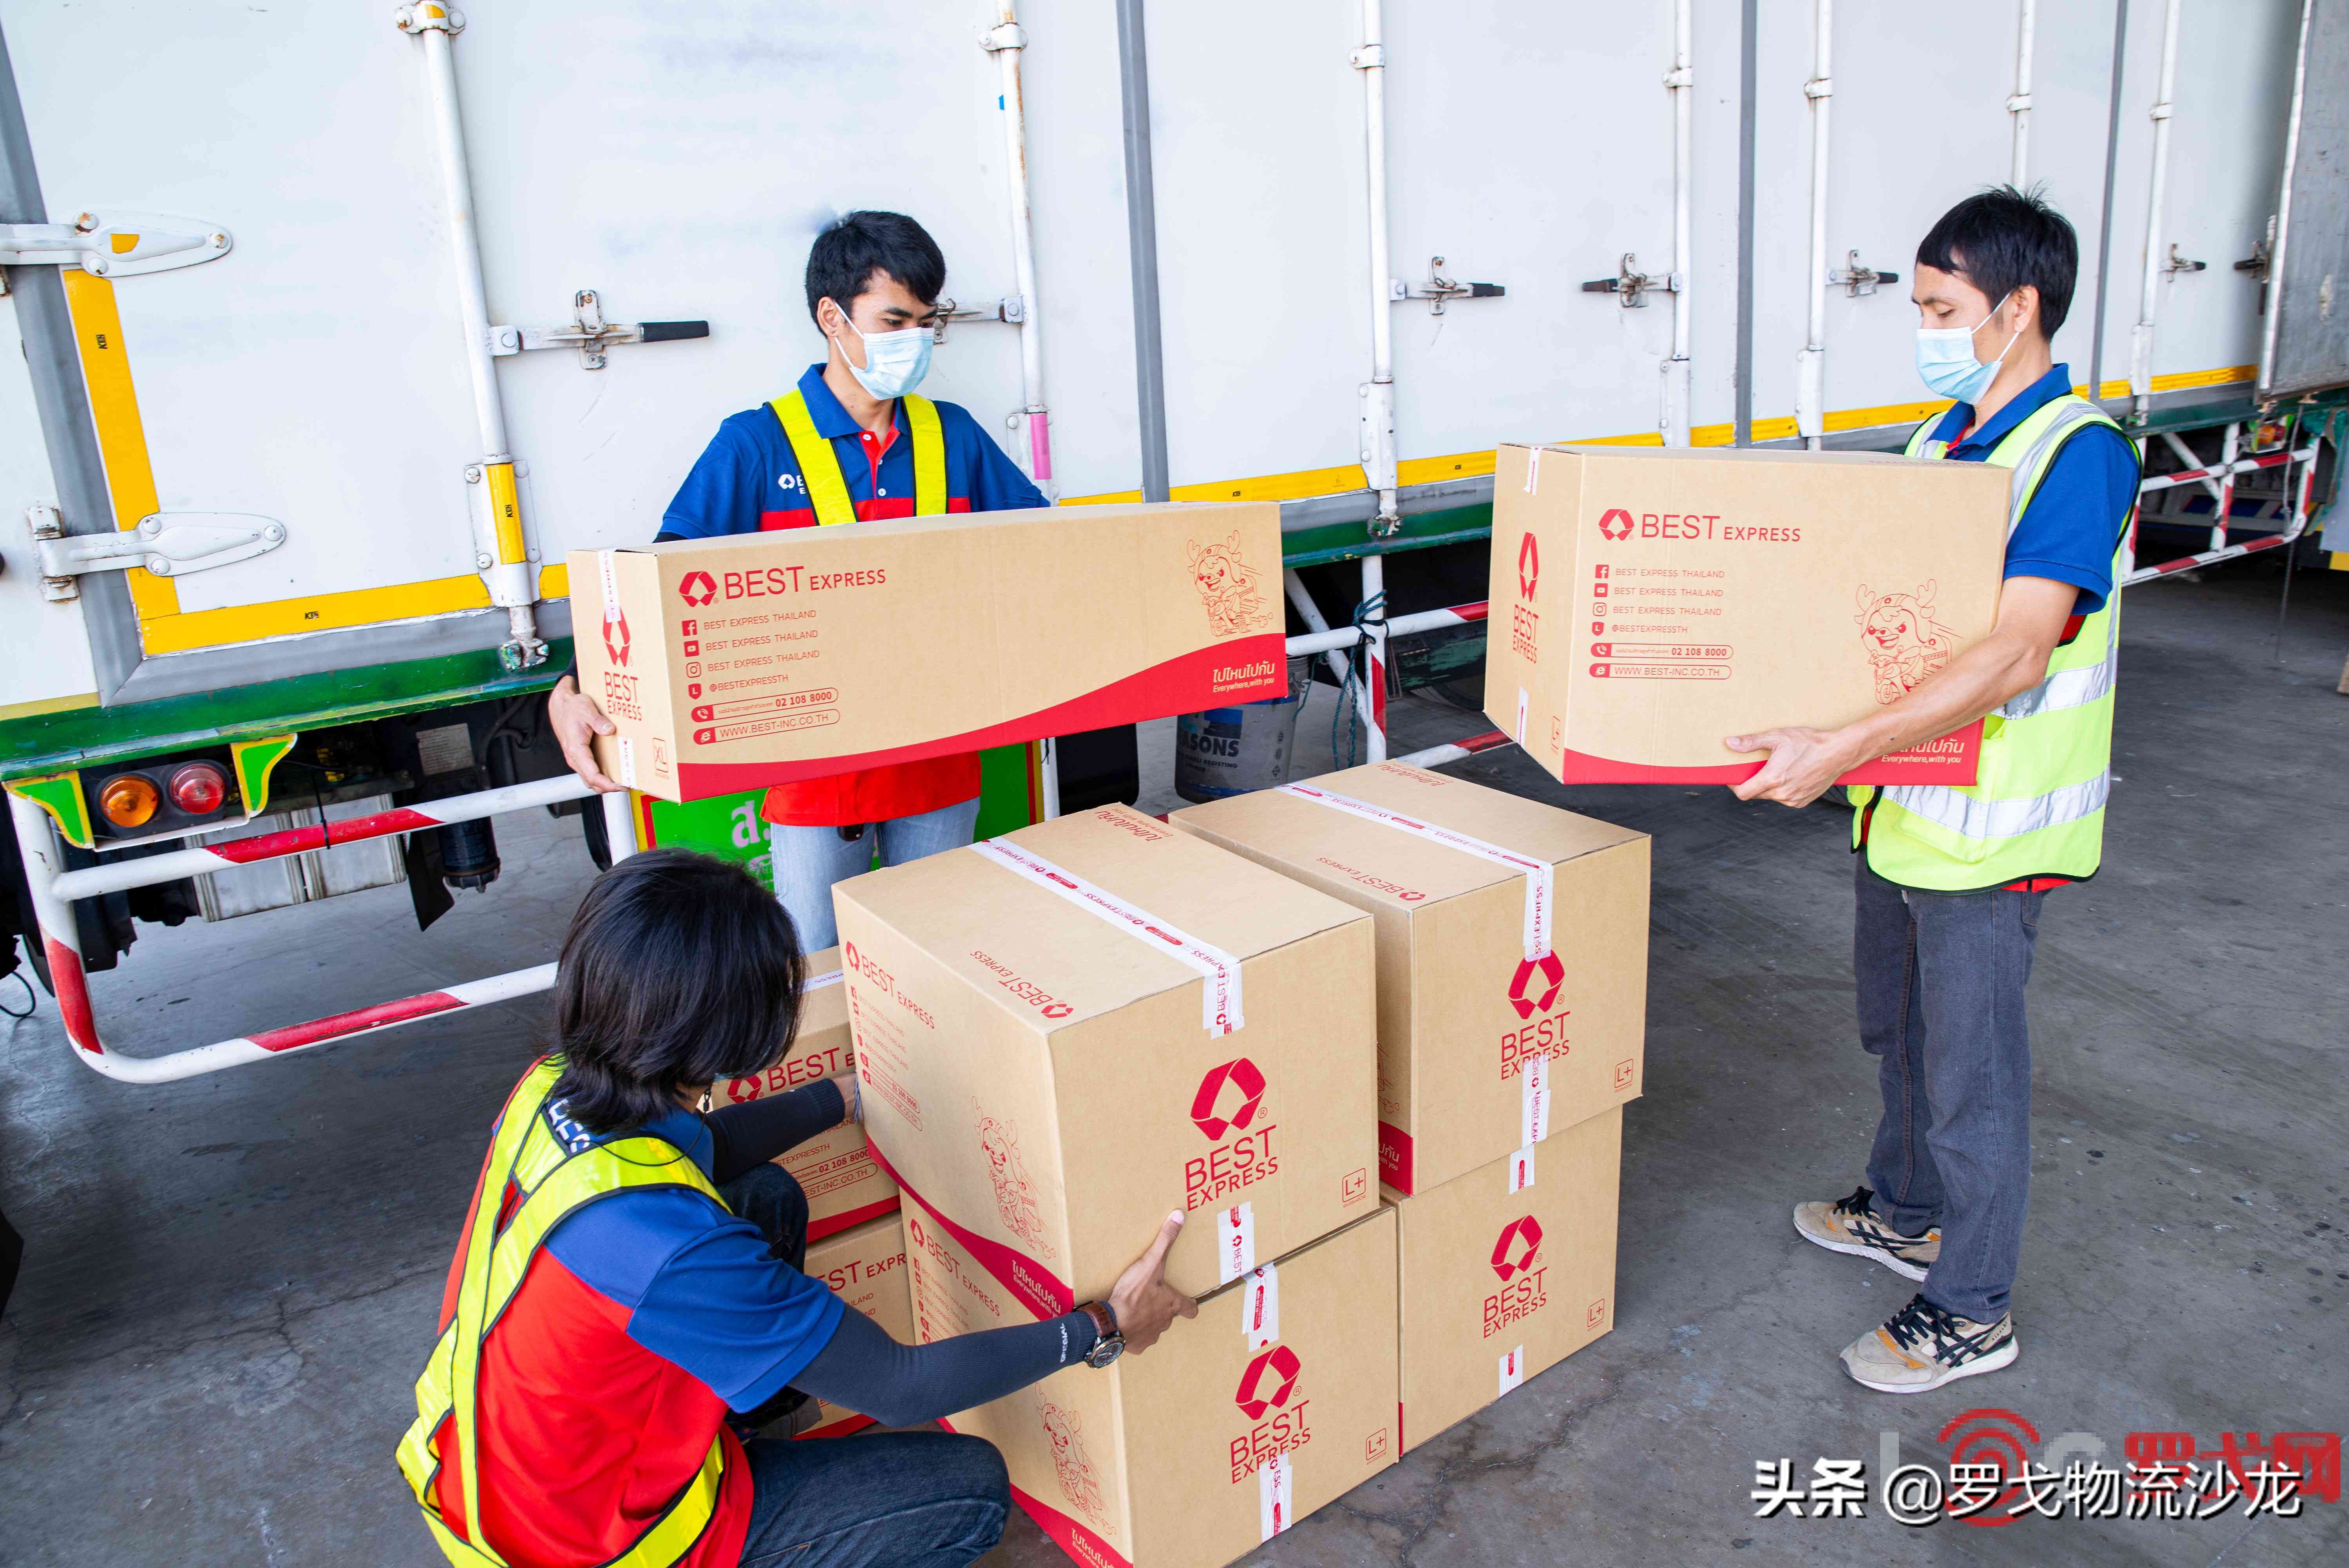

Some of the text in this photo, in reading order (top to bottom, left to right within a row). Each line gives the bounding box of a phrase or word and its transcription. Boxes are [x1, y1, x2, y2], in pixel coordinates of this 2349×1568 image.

[1641, 514, 1801, 542] BEST EXPRESS
[724, 566, 886, 599] BEST EXPRESS
[704, 610, 816, 630] BEST EXPRESS THAILAND
[1514, 604, 1539, 644] BEST
[1612, 624, 1688, 633] @BESTEXPRESSTH
[706, 630, 818, 651] BEST EXPRESS THAILAND
[1513, 635, 1537, 664] EXPRESS
[708, 650, 820, 671] BEST EXPRESS THAILAND
[1615, 667, 1720, 676] WWW.BEST-INC.CO.TH
[604, 671, 638, 703] BEST
[709, 674, 789, 692] @BESTEXPRESSTH
[1263, 677, 1274, 686] you
[607, 700, 642, 721] EXPRESS
[775, 691, 832, 707] 02 108 8000
[720, 714, 829, 738] WWW.BEST-INC.CO.TH
[654, 745, 667, 765] XL
[1316, 857, 1404, 893] BEST EXPRESS
[1533, 886, 1544, 933] EXPRESS
[861, 955, 934, 1029] BEST EXPRESS
[970, 951, 1054, 1006] BEST EXPRESS
[1217, 983, 1226, 1011] BEST
[1501, 1011, 1570, 1063] BEST
[767, 1047, 840, 1092] BEST
[1617, 1066, 1632, 1082] L+
[819, 1164, 829, 1173] 02
[832, 1158, 847, 1169] 108
[1185, 1124, 1276, 1193] BEST
[804, 1168, 867, 1195] EST-INC.CO.TH
[1187, 1157, 1278, 1212] EXPRESS
[1346, 1177, 1363, 1196] L+
[866, 1253, 906, 1278] EXPR
[927, 1234, 999, 1317] BEST EXPRESS
[1484, 1266, 1547, 1323] BEST
[1483, 1292, 1546, 1339] EXPRESS
[1589, 1306, 1603, 1322] L+
[1230, 1400, 1309, 1468] BEST
[1369, 1436, 1384, 1454] L+
